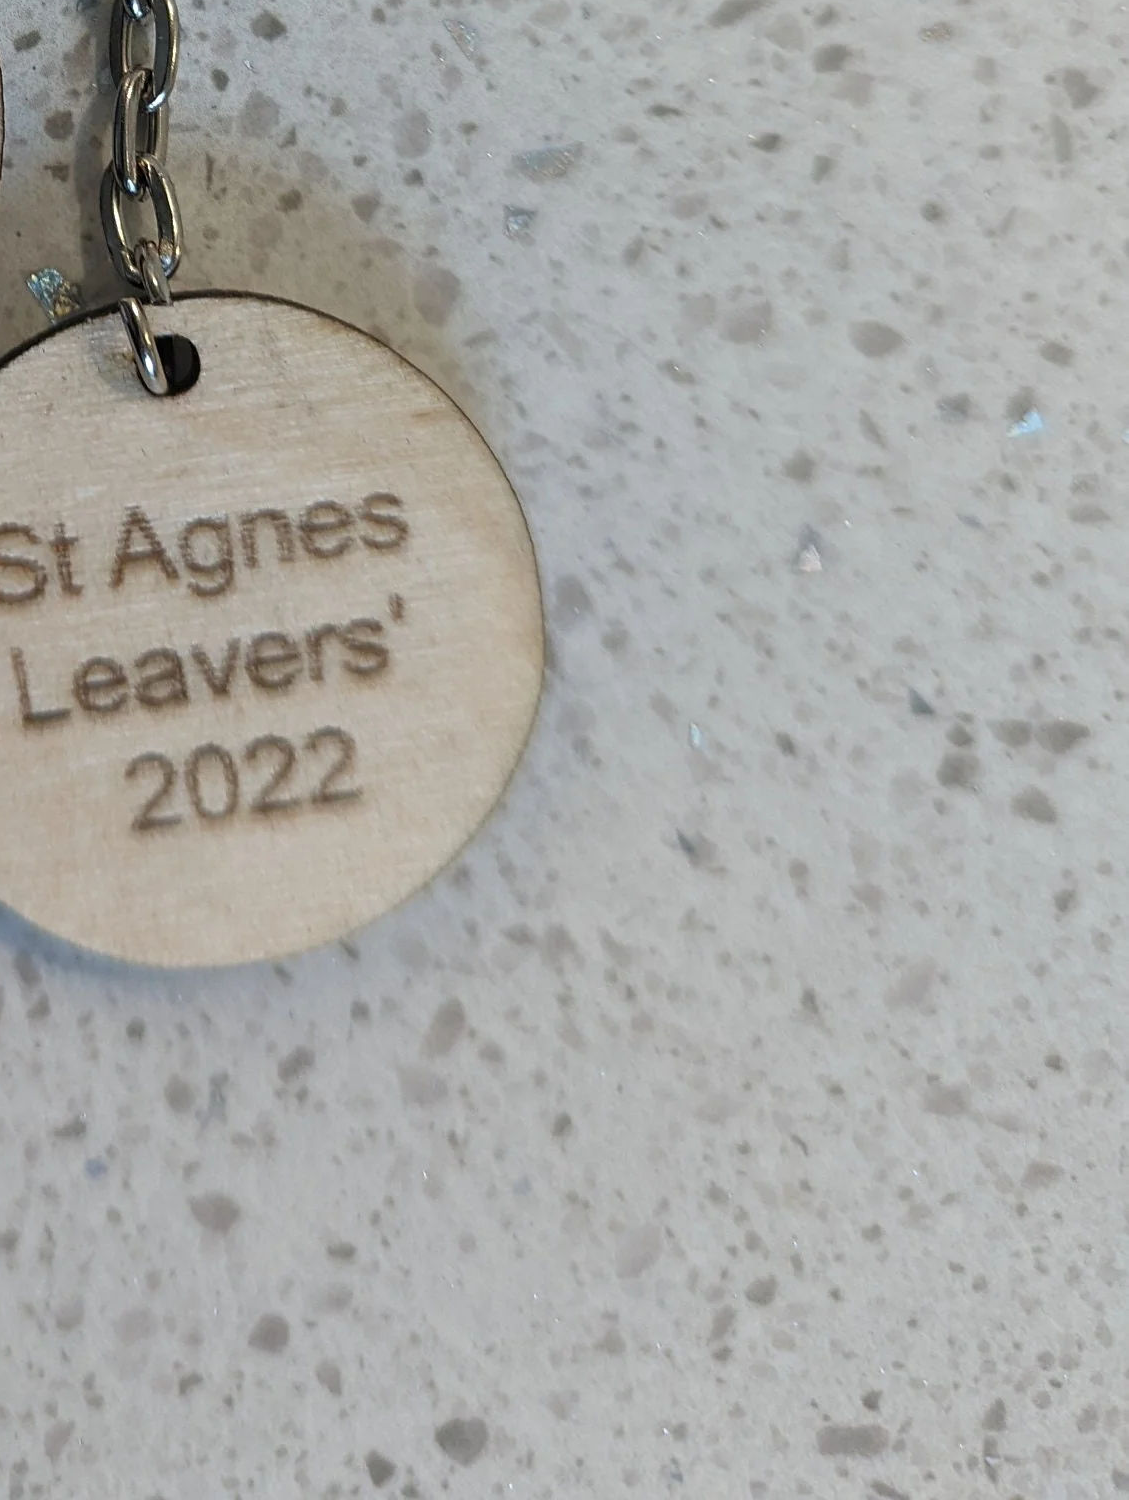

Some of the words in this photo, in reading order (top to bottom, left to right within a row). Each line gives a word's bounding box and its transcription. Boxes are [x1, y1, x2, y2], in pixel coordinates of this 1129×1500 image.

[108, 491, 410, 598] Agnes
[9, 592, 406, 729] Leavers'
[123, 725, 365, 834] 2022
